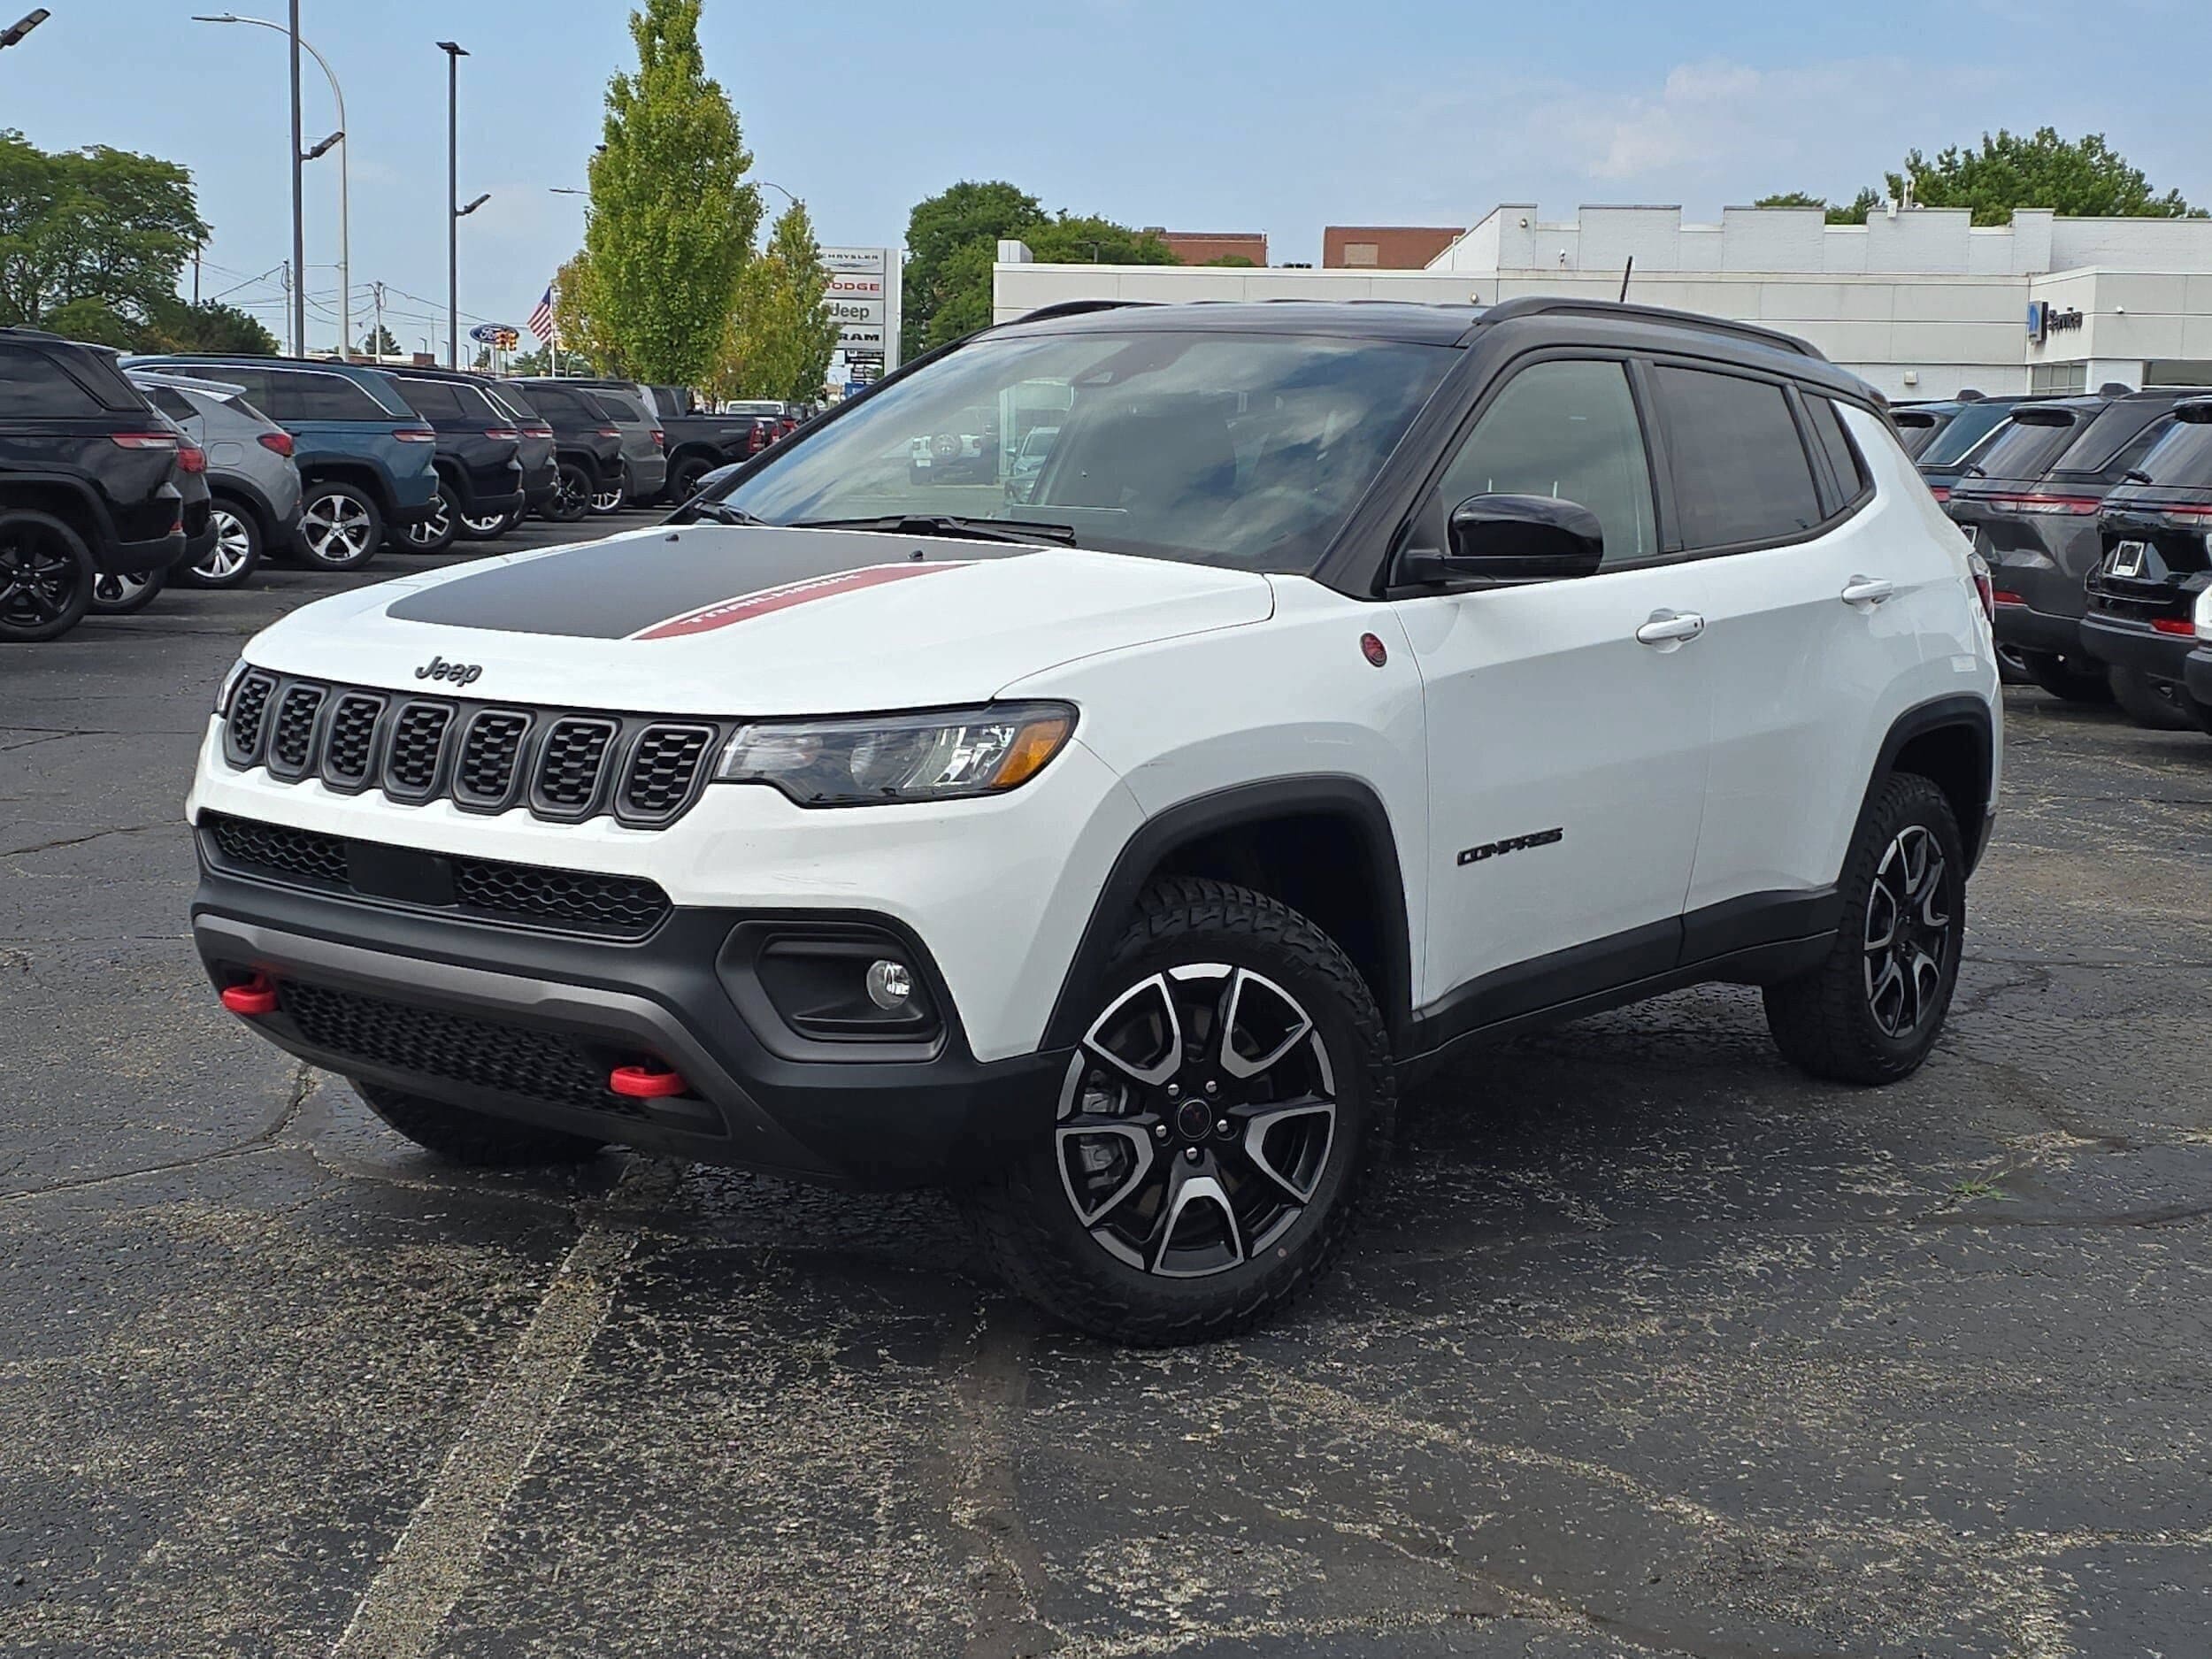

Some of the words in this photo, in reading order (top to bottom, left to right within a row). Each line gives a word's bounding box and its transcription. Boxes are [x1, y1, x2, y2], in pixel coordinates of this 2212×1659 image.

[830, 303, 870, 320] Jeep
[839, 333, 879, 342] RAM
[679, 574, 861, 625] TRAILHAWK
[415, 656, 482, 687] Jeep
[1457, 827, 1563, 866] COMPASS
